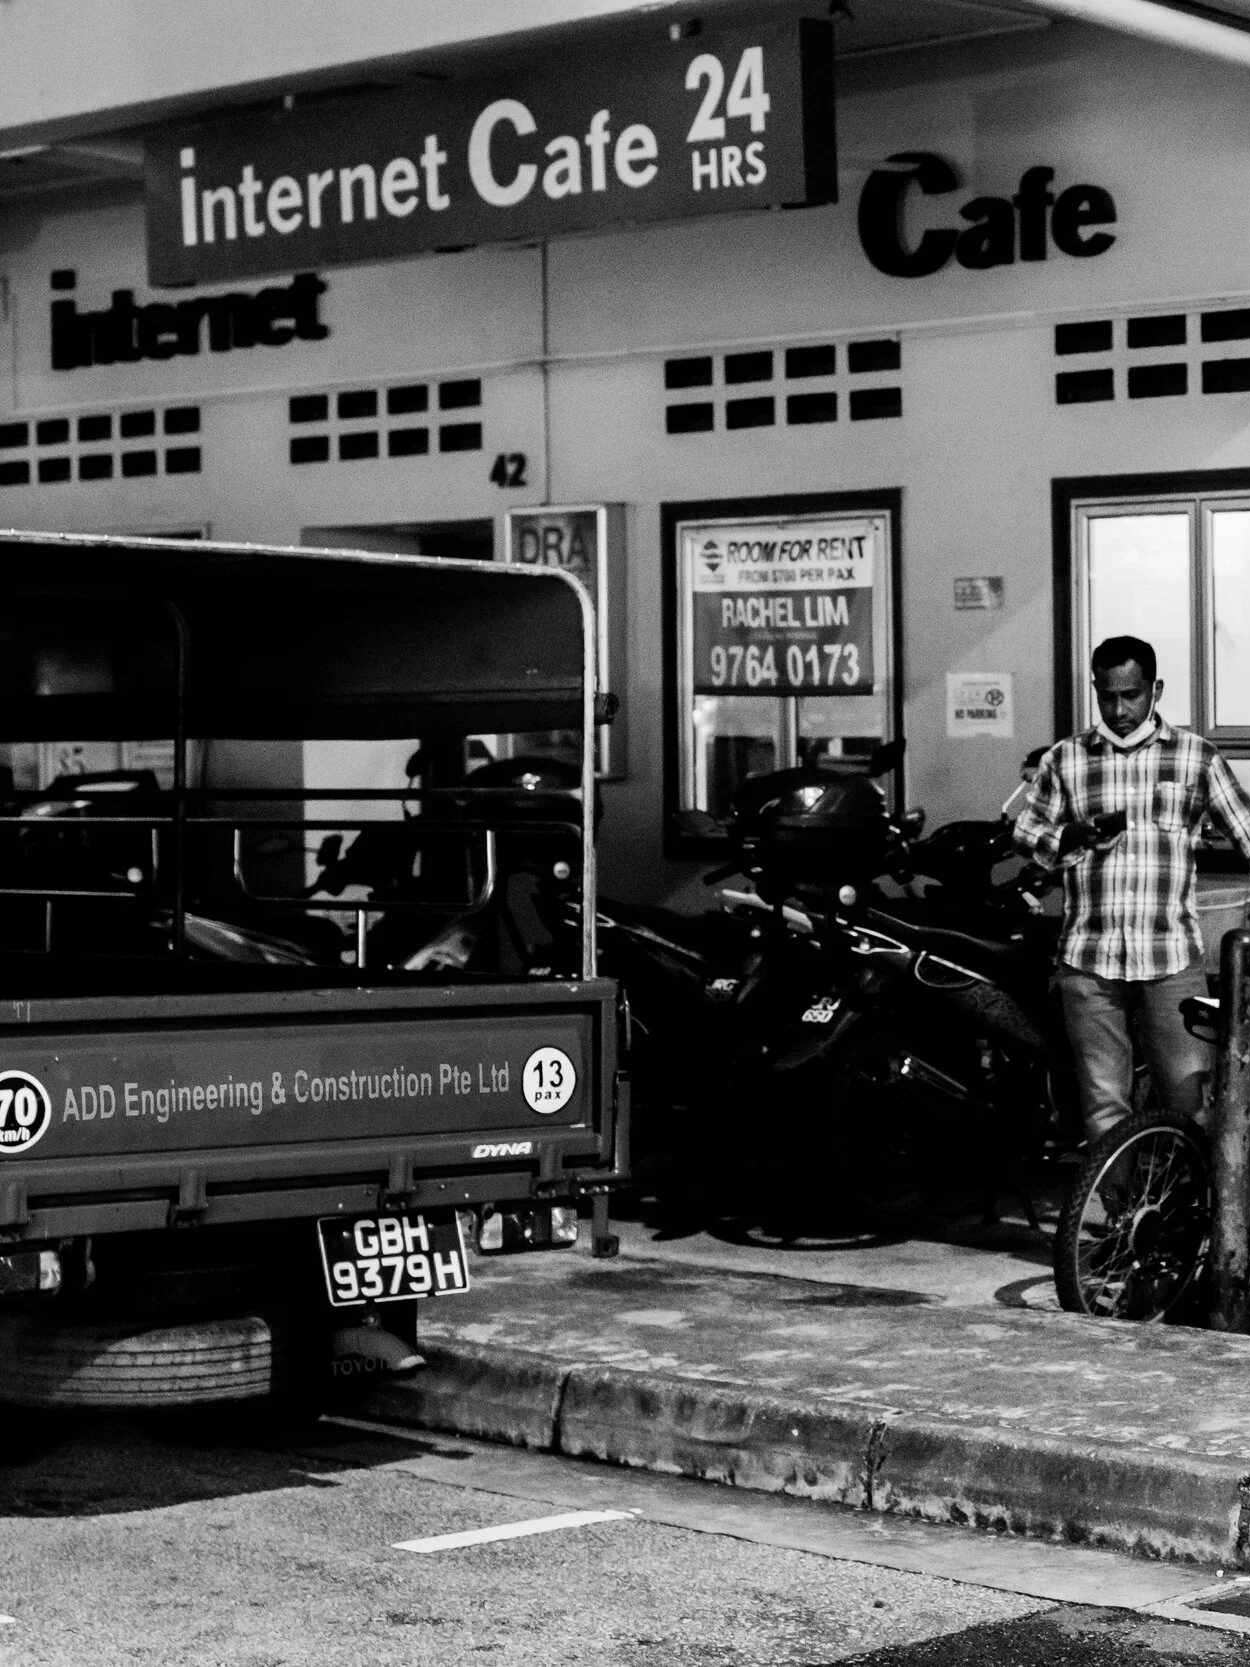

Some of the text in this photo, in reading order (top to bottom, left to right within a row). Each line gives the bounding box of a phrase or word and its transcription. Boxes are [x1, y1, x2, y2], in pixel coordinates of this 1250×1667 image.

[685, 46, 771, 143] 24
[180, 98, 658, 246] internet Cafe
[692, 141, 767, 191] HRS
[51, 151, 1117, 371] internet Cafe
[489, 453, 528, 488] 42
[727, 536, 866, 563] ROOM FOR RENT
[800, 568, 824, 582] PER
[827, 566, 856, 581] PAX
[721, 595, 849, 628] RACHEL LIM
[711, 643, 860, 687] 9764 0173
[63, 1061, 509, 1122] ADD Engineering & Construction Pte Ltd
[533, 1060, 564, 1088] 13
[534, 1091, 561, 1102] pax
[472, 1141, 532, 1158] DYNA
[354, 1215, 429, 1257] GBH
[333, 1250, 463, 1299] 9379H
